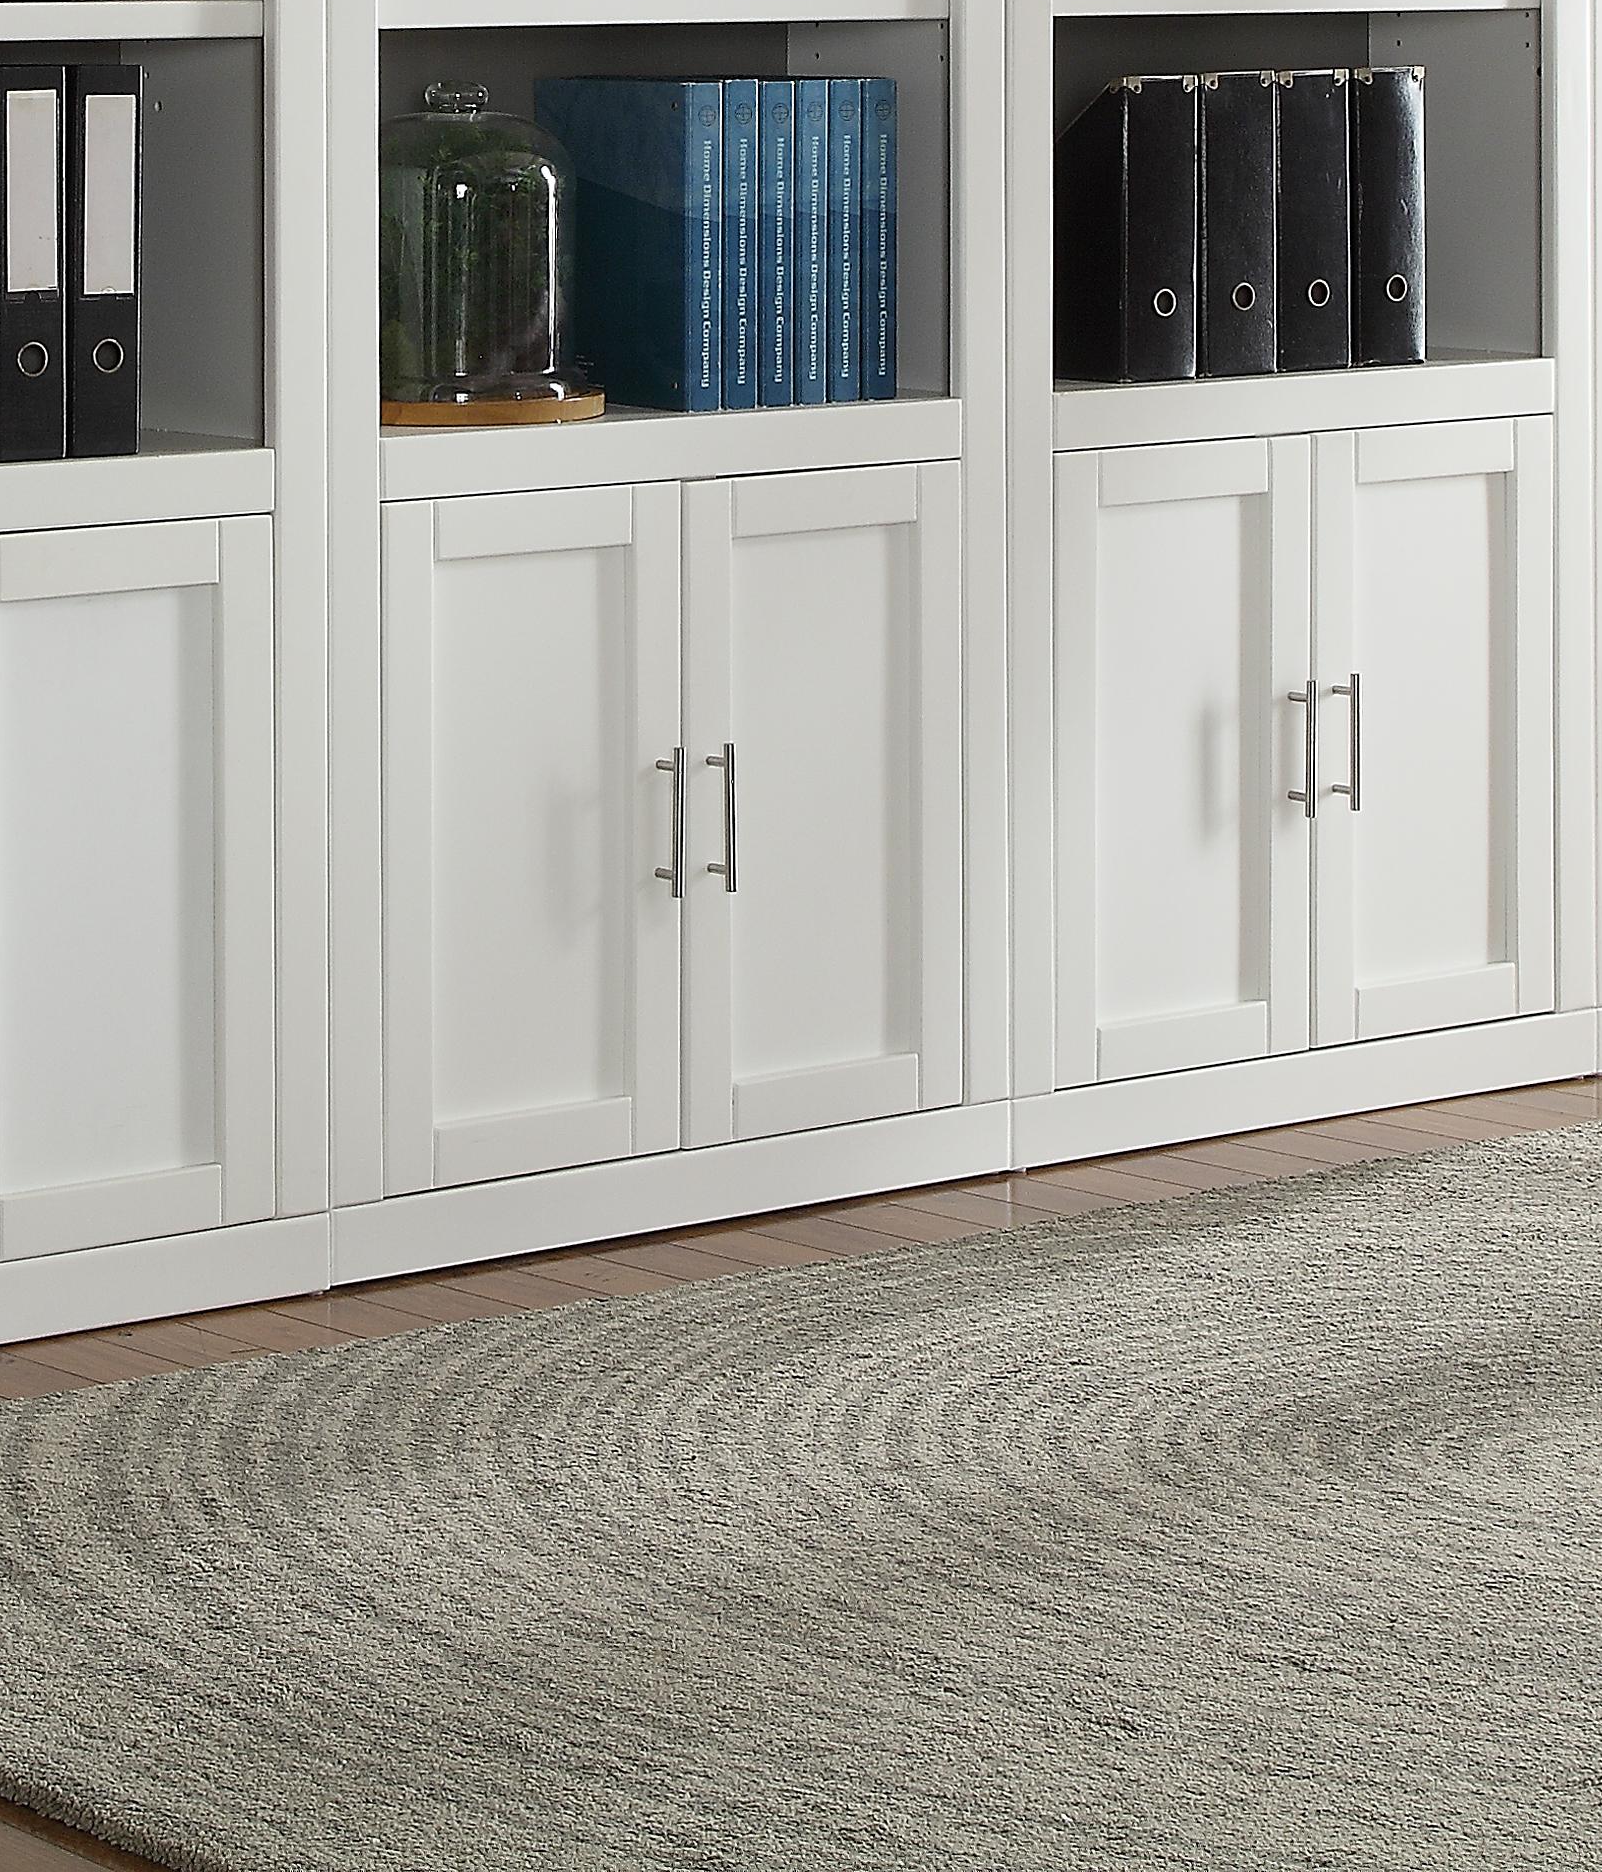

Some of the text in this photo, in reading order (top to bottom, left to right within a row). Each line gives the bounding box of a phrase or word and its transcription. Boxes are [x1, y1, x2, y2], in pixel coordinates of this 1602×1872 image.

[701, 140, 711, 388] Home Dimensions Design Company
[738, 139, 747, 385] Home Dimensions Design Company
[775, 138, 784, 383] Home Dimensions Design Company
